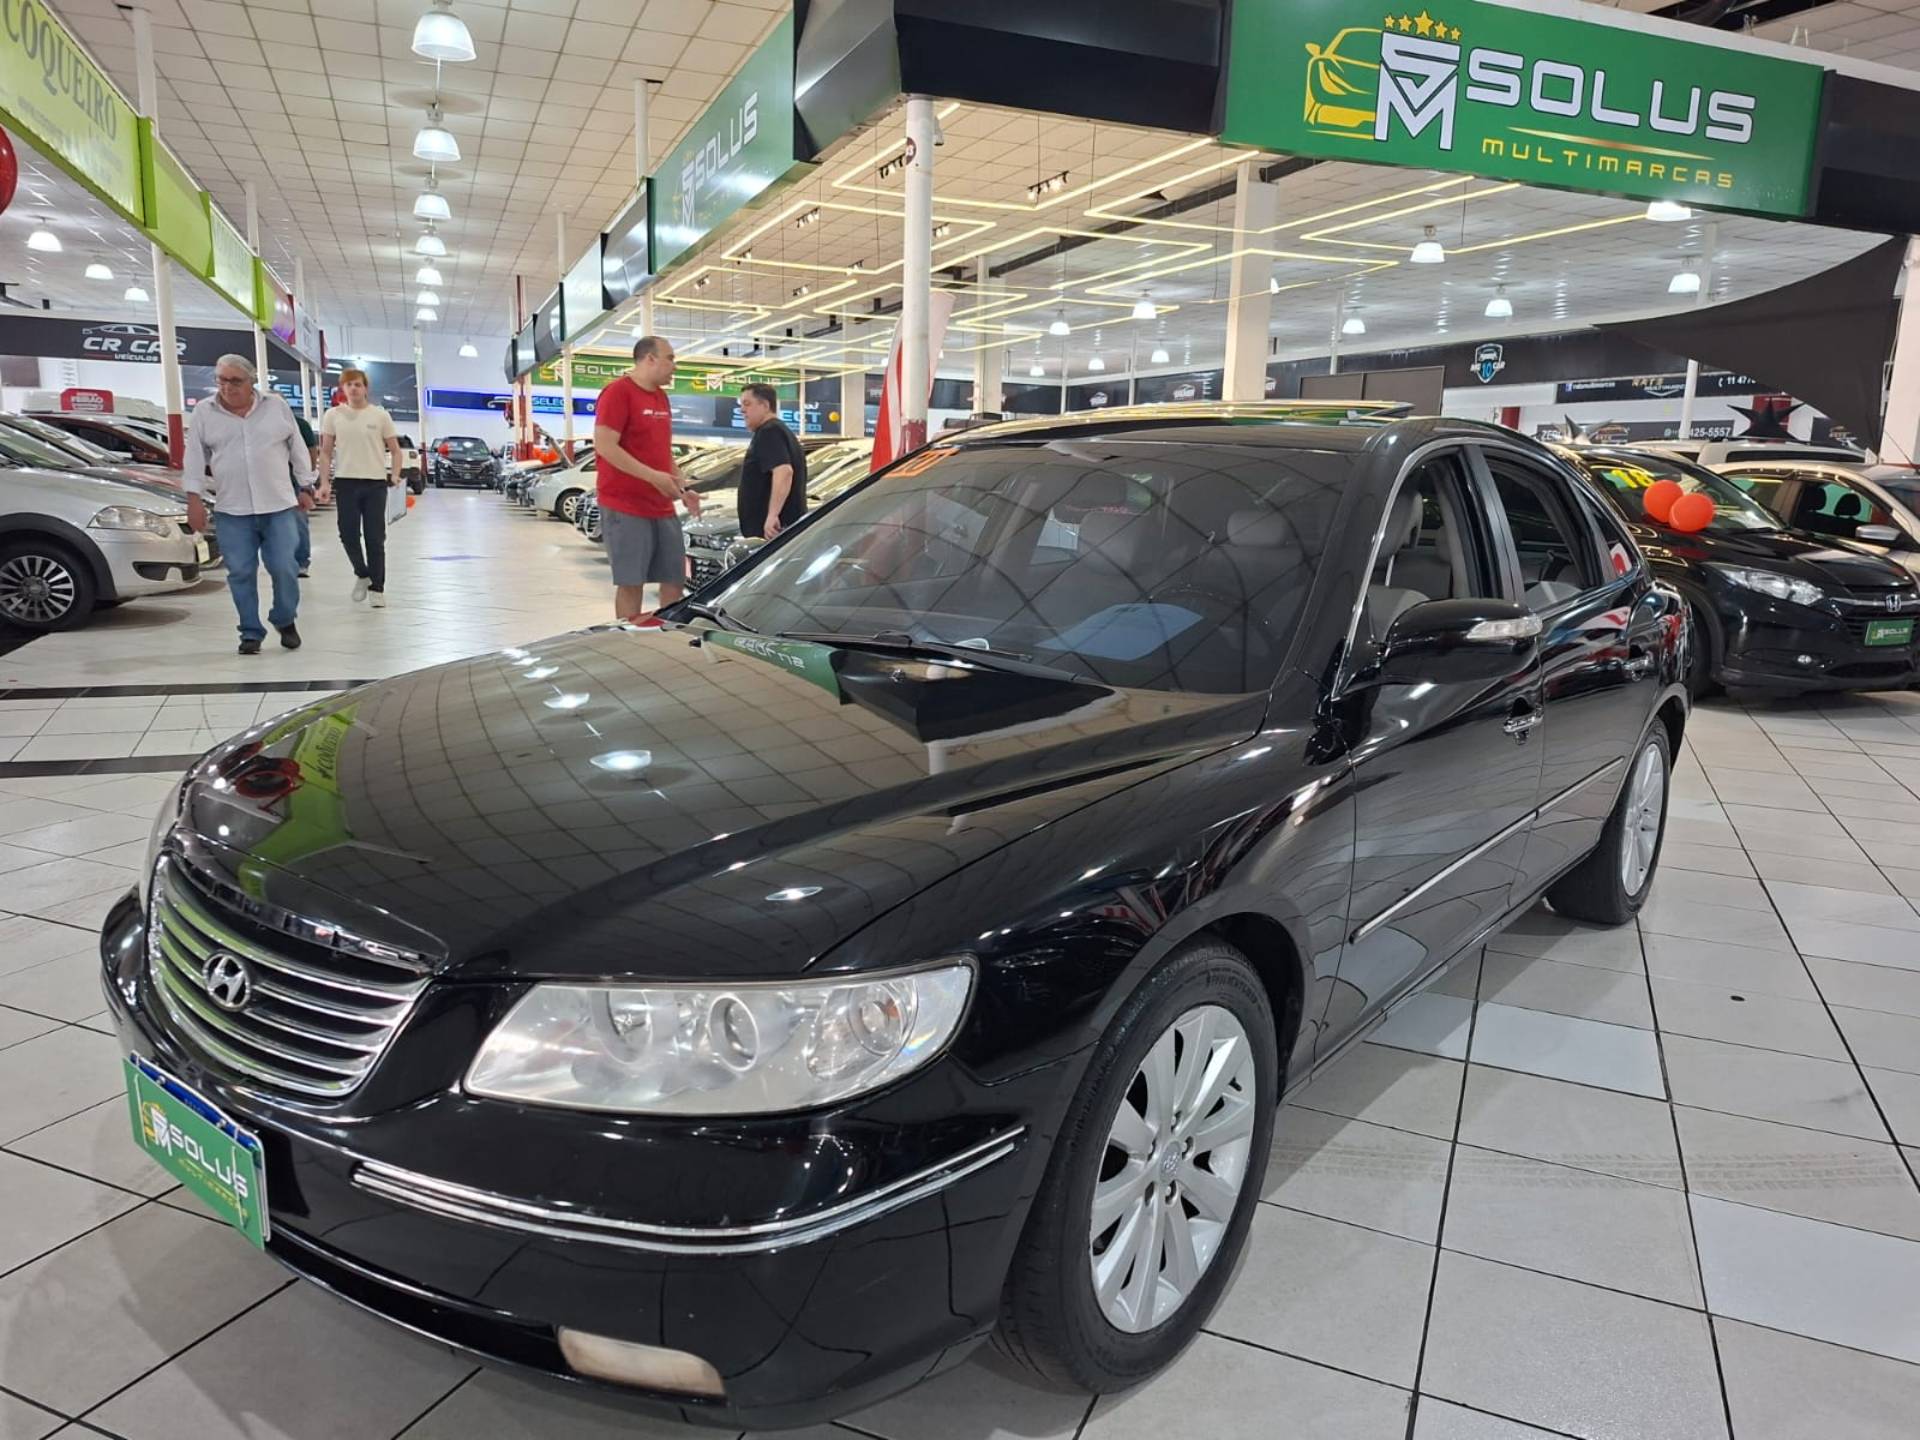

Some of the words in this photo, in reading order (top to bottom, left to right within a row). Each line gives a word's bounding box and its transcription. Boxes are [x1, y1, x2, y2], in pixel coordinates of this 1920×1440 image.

[2, 0, 117, 141] COQUEIRO
[1466, 46, 1757, 145] SOLUS
[695, 91, 758, 192] SOLUS
[1481, 137, 1735, 190] MULTIMARCAS
[83, 336, 122, 351] CR
[574, 364, 625, 377] SOLU
[172, 1130, 248, 1199] SOLUS
